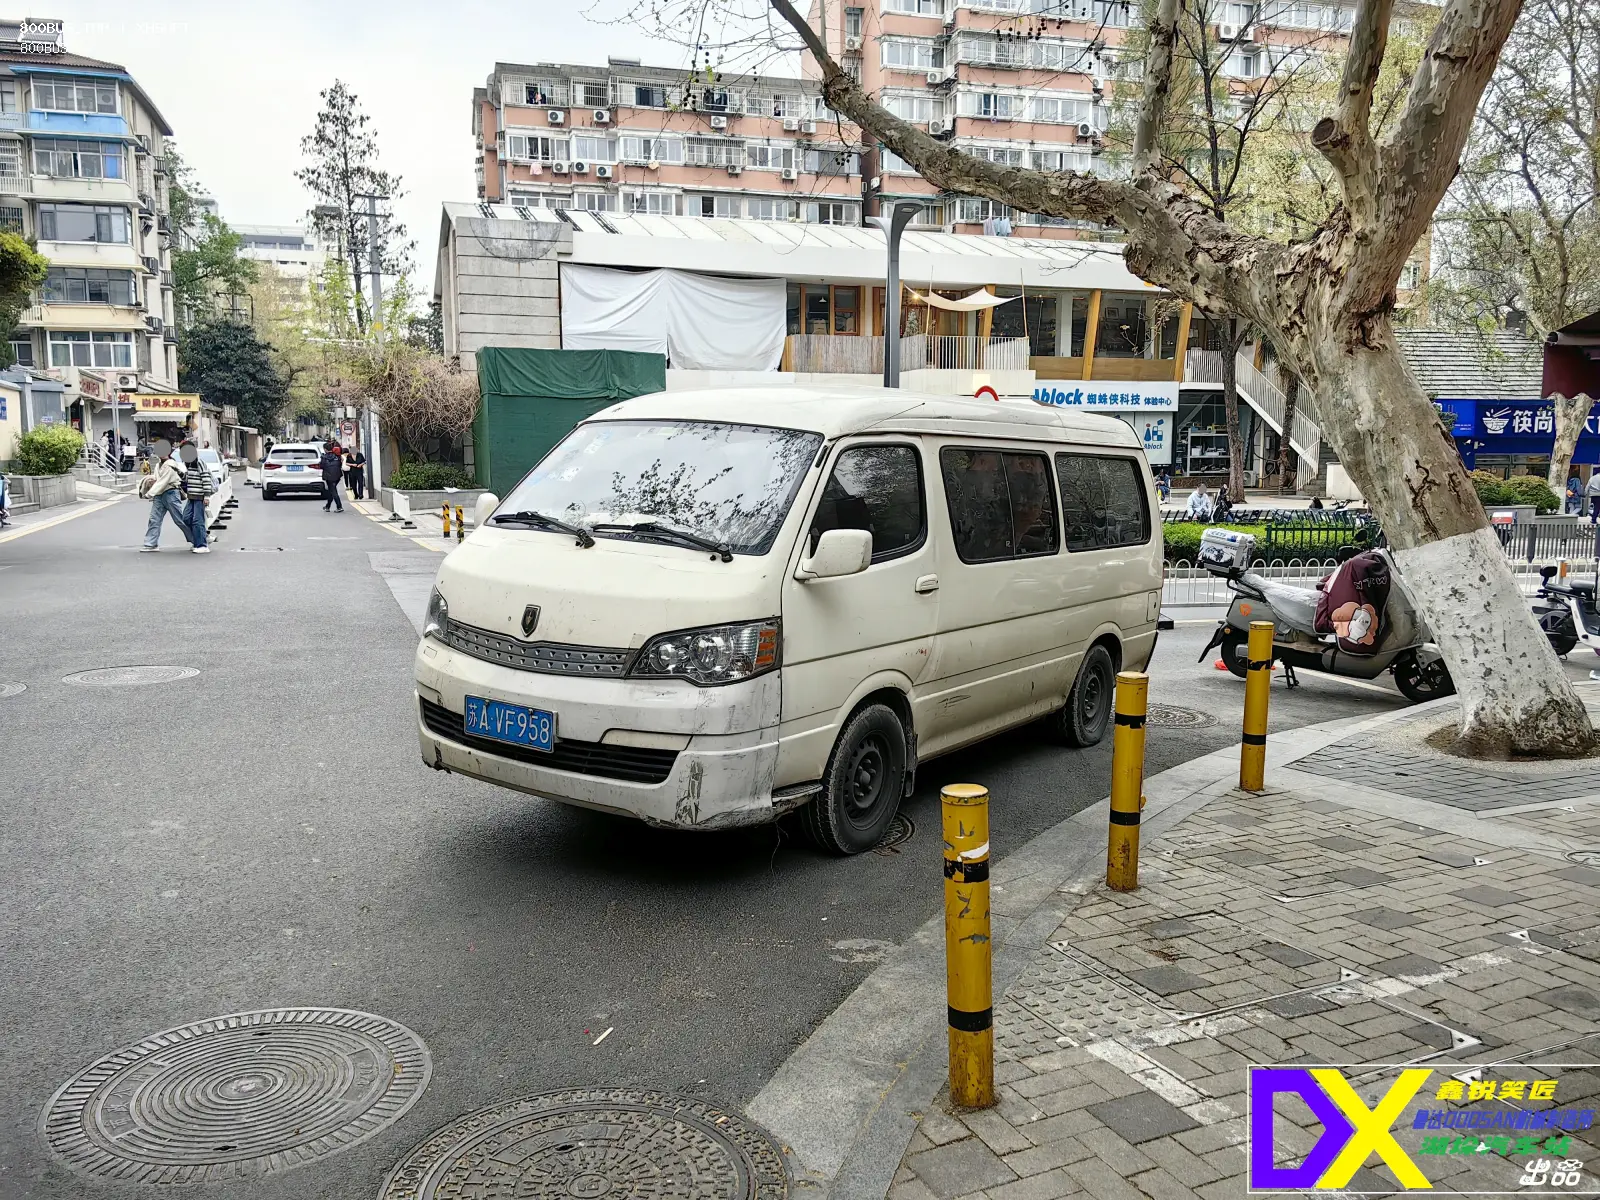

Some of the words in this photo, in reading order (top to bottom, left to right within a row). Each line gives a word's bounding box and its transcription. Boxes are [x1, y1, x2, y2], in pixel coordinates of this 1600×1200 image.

[1087, 393, 1141, 405] 蜘蛛侠科技
[1144, 397, 1172, 406] 体验中心
